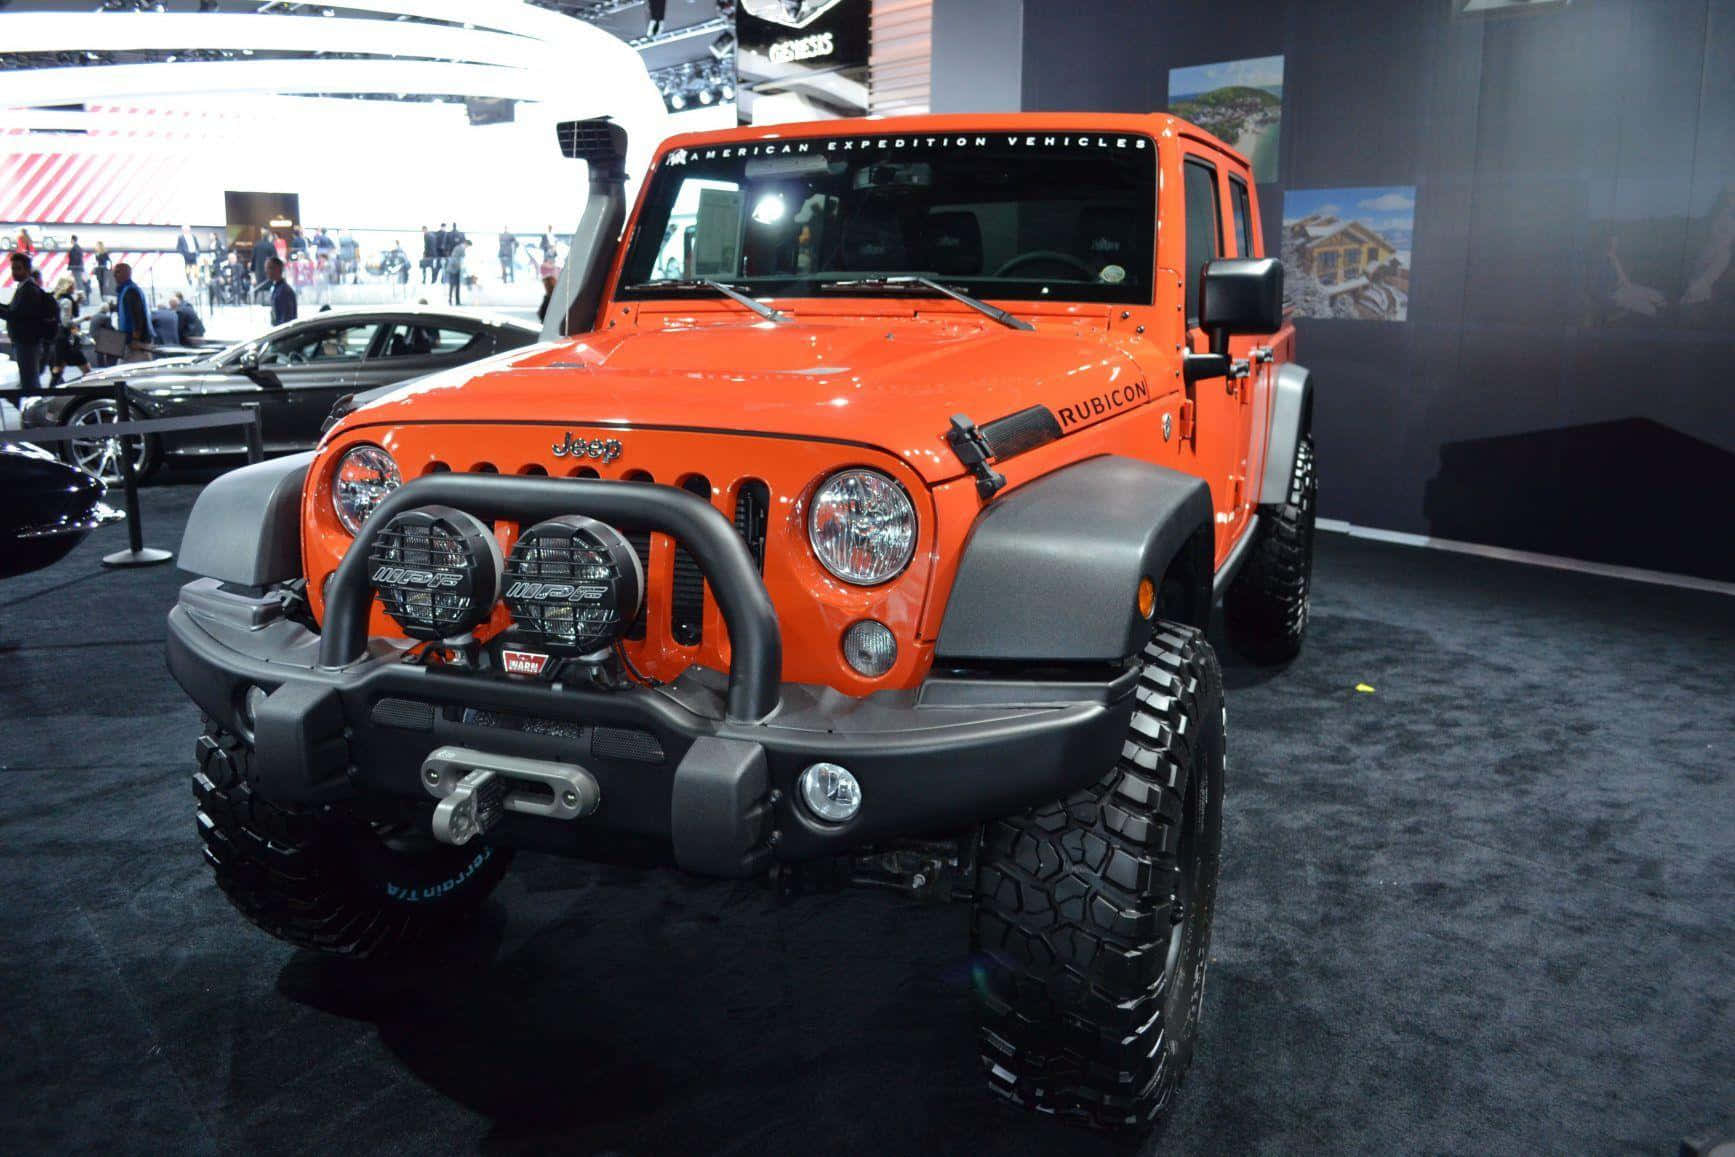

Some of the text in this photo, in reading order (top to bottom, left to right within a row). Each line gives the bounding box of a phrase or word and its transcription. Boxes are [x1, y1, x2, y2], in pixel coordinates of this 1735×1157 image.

[769, 32, 834, 64] GENESIS
[690, 136, 1146, 161] AMERICAN EXPEDITION VEHICLES
[1058, 380, 1147, 427] RUBICON
[551, 431, 623, 464] Jeep
[509, 659, 539, 673] WARN
